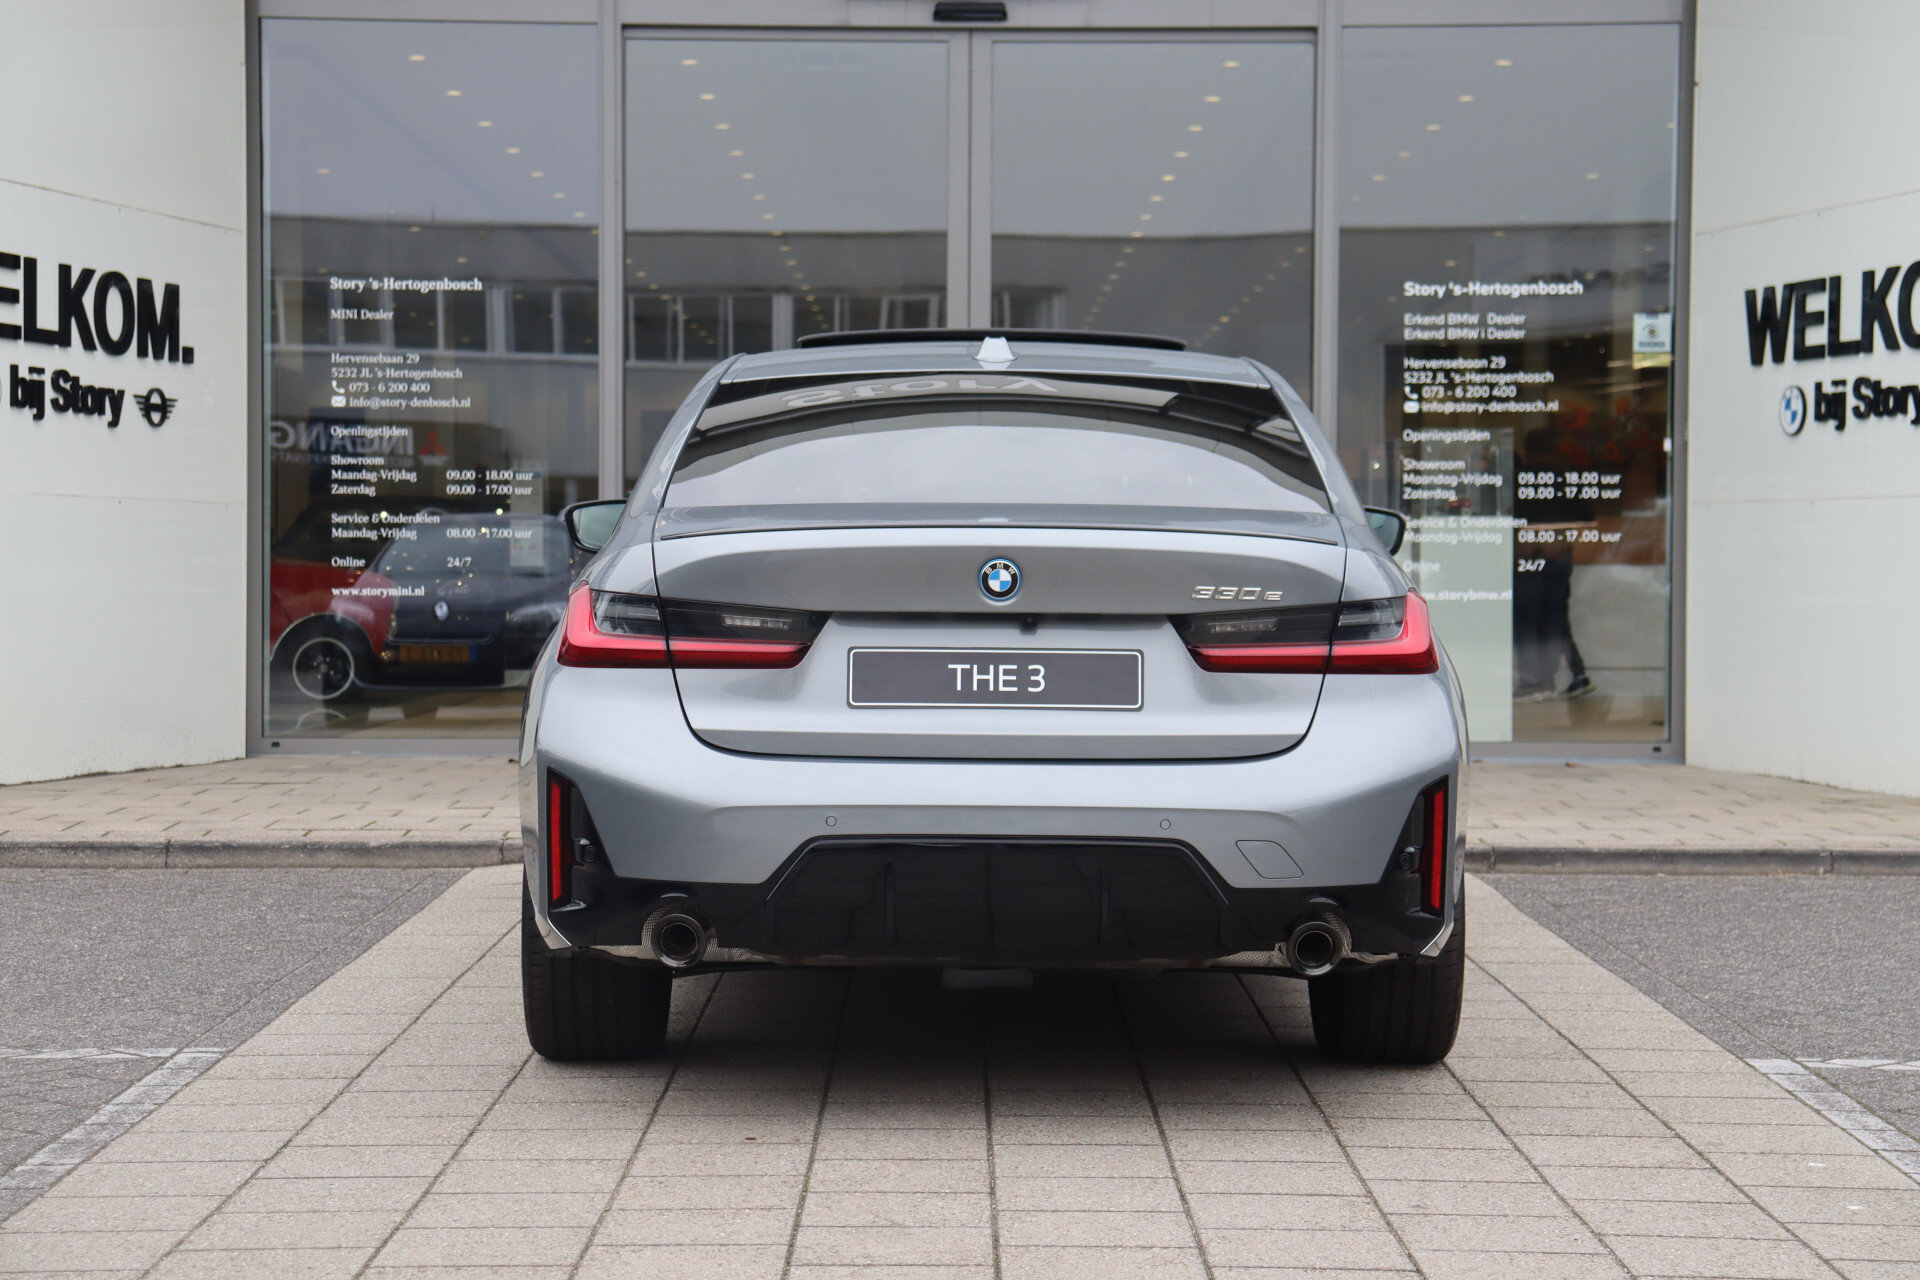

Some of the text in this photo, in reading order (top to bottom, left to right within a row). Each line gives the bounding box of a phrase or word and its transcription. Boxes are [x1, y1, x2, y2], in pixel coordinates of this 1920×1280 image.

[330, 277, 483, 293] Story 's-Hertogenbosch
[1403, 280, 1584, 299] Story 's-Hertogenbosch
[330, 309, 394, 320] MINI Dealer
[1404, 312, 1526, 326] Erkend BMW Dealer
[1404, 327, 1526, 340] Erkend BMW i Dealer
[331, 353, 420, 364] Hervensebaan 29
[1403, 356, 1506, 369] Hervensebaan 29
[331, 368, 463, 380] 5232 JL 's-Hertogenbosch
[1404, 371, 1554, 385] 5232 JL 's-Hertogenbosch
[349, 383, 369, 393] 073
[378, 383, 386, 393] 6
[388, 383, 408, 393] 200
[410, 383, 430, 393] 400
[1421, 386, 1445, 398] 073
[1455, 386, 1463, 398] 6
[1466, 386, 1490, 398] 200
[1491, 386, 1517, 398] 400
[10, 364, 125, 427] bij Story
[350, 397, 471, 410] info@story-denbosch.nl
[1421, 399, 1559, 414] info@story-denbosch.nl
[1814, 379, 1847, 432] bij
[330, 426, 409, 438] Openingstijden
[1403, 429, 1490, 443] Openingstijden
[331, 455, 385, 466] Showroom
[1402, 458, 1465, 470] Showroom
[331, 470, 417, 482] Maandag-Vrijdag
[446, 470, 476, 481] 09.00
[485, 470, 513, 481] 18.00
[515, 473, 534, 481] uur
[1403, 473, 1502, 487] Maandag-Vrijdag
[1518, 472, 1554, 484] 09.00
[1565, 472, 1599, 484] 18.00
[1601, 474, 1621, 484] uur
[331, 484, 376, 497] Zaterdag
[446, 485, 476, 495] 09.00
[485, 485, 513, 495] 17.00
[514, 487, 533, 495] uur
[1402, 488, 1457, 501] Zaterdag
[1518, 487, 1554, 499] 09.00
[1601, 489, 1622, 499] uur
[331, 513, 440, 524] Service & Onderdelen
[331, 528, 417, 541] Maandag-Vrijdag
[447, 528, 476, 539] 08.00
[485, 528, 513, 539] 17.00
[514, 530, 533, 539] uur
[1403, 530, 1502, 544] Maandag-Vrijdag
[1518, 530, 1554, 543] 08.00
[1601, 532, 1622, 542] uur
[331, 556, 472, 568] Online 24/7
[984, 562, 1016, 575] BMW
[1402, 559, 1546, 573] Online 24/7
[331, 586, 425, 598] www.storymini.nl
[1191, 585, 1283, 600] 330e
[1421, 589, 1512, 602] w.storybmw.nl
[948, 664, 1046, 693] THE 3
